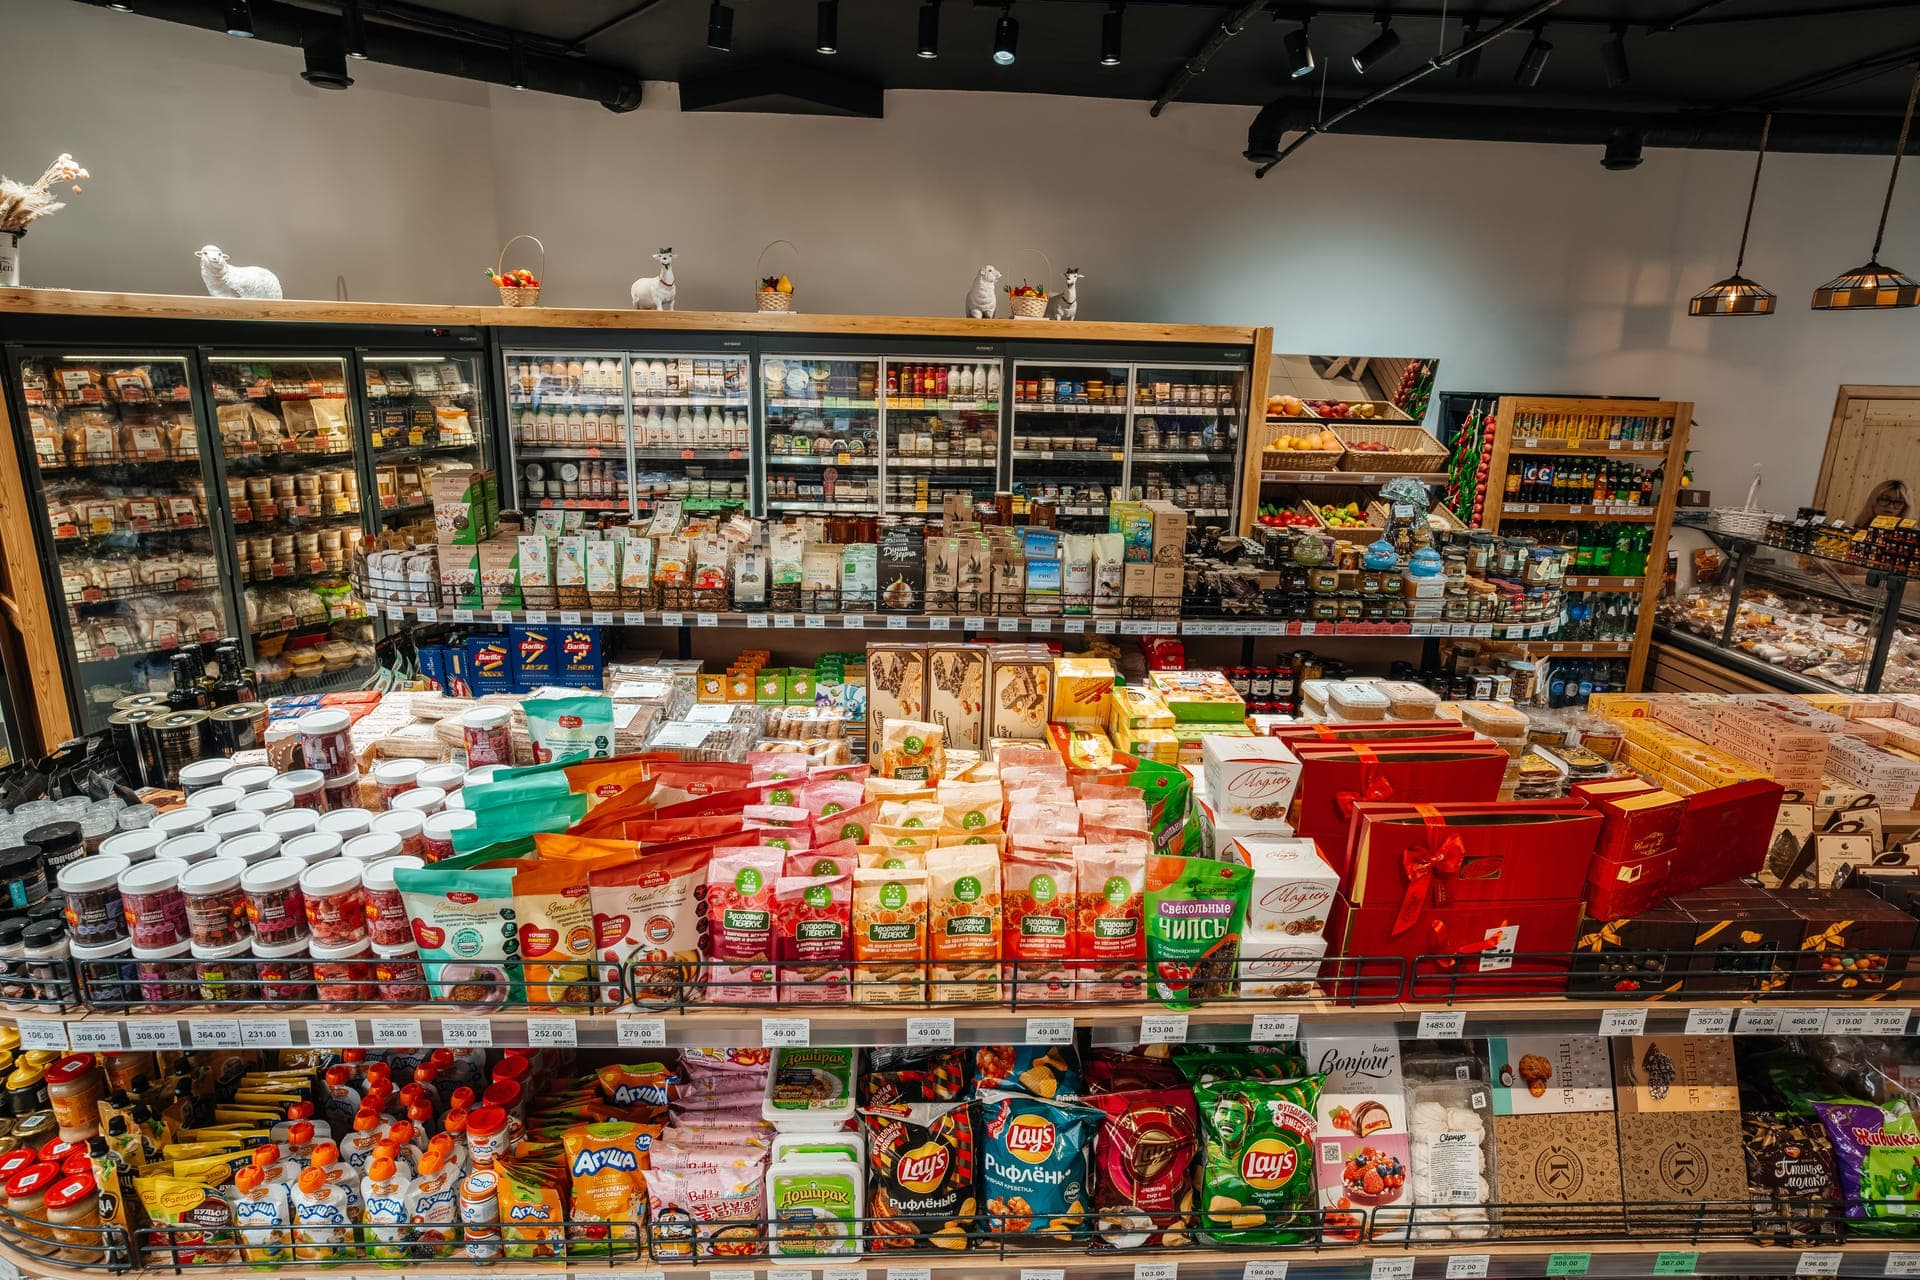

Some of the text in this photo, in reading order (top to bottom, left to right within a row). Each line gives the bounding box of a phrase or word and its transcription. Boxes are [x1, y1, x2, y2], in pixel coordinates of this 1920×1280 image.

[1161, 902, 1231, 915] Свекольные
[727, 911, 764, 922] Здоровый
[733, 919, 762, 928] ПЕРЕКУС
[951, 918, 986, 927] Здоровый
[1025, 918, 1060, 926] Здоровый
[1099, 920, 1134, 929] Здоровый
[800, 923, 837, 933] Здоровый
[873, 925, 911, 934] Здоровый
[955, 924, 985, 933] ПЕРЕКУС
[1030, 925, 1058, 933] ПЕРЕКУС
[1104, 927, 1131, 935] ПЕРЕКУС
[1158, 917, 1230, 941] ЧИПСЫ
[806, 929, 835, 937] ПЕРЕКУС
[878, 931, 909, 940] ПЕРЕКУС
[1425, 1021, 1456, 1029] 1485.00
[1611, 1018, 1638, 1026] 314.00
[1873, 1017, 1901, 1025] 319.00
[136, 1032, 166, 1040] 308.00
[197, 1031, 227, 1039] 364.00
[248, 1030, 277, 1038] 231.00
[315, 1030, 344, 1038] 231.00
[379, 1030, 408, 1038] 308.00
[918, 1028, 941, 1036] 49.00
[1037, 1028, 1060, 1036] 49.00
[76, 1033, 106, 1041] 308.00
[783, 1052, 846, 1066] Доширак
[1318, 1048, 1395, 1078] Bonjour
[1560, 1042, 1575, 1105] ПЕЧЕНЬЕ
[1683, 1042, 1700, 1105] ПЕЧЕНЬЕ
[1010, 1124, 1053, 1152] Lay's
[573, 1149, 637, 1176] АГУША
[901, 1152, 946, 1182] Lay's
[1246, 1151, 1294, 1181] Lay's
[1775, 1157, 1825, 1178] Птичье
[1784, 1175, 1828, 1188] молоко
[780, 1188, 849, 1208] Доширак
[889, 1191, 958, 1211] Рифлёные
[193, 1208, 229, 1217] БУЛЬОН
[237, 1202, 277, 1218] АГУША
